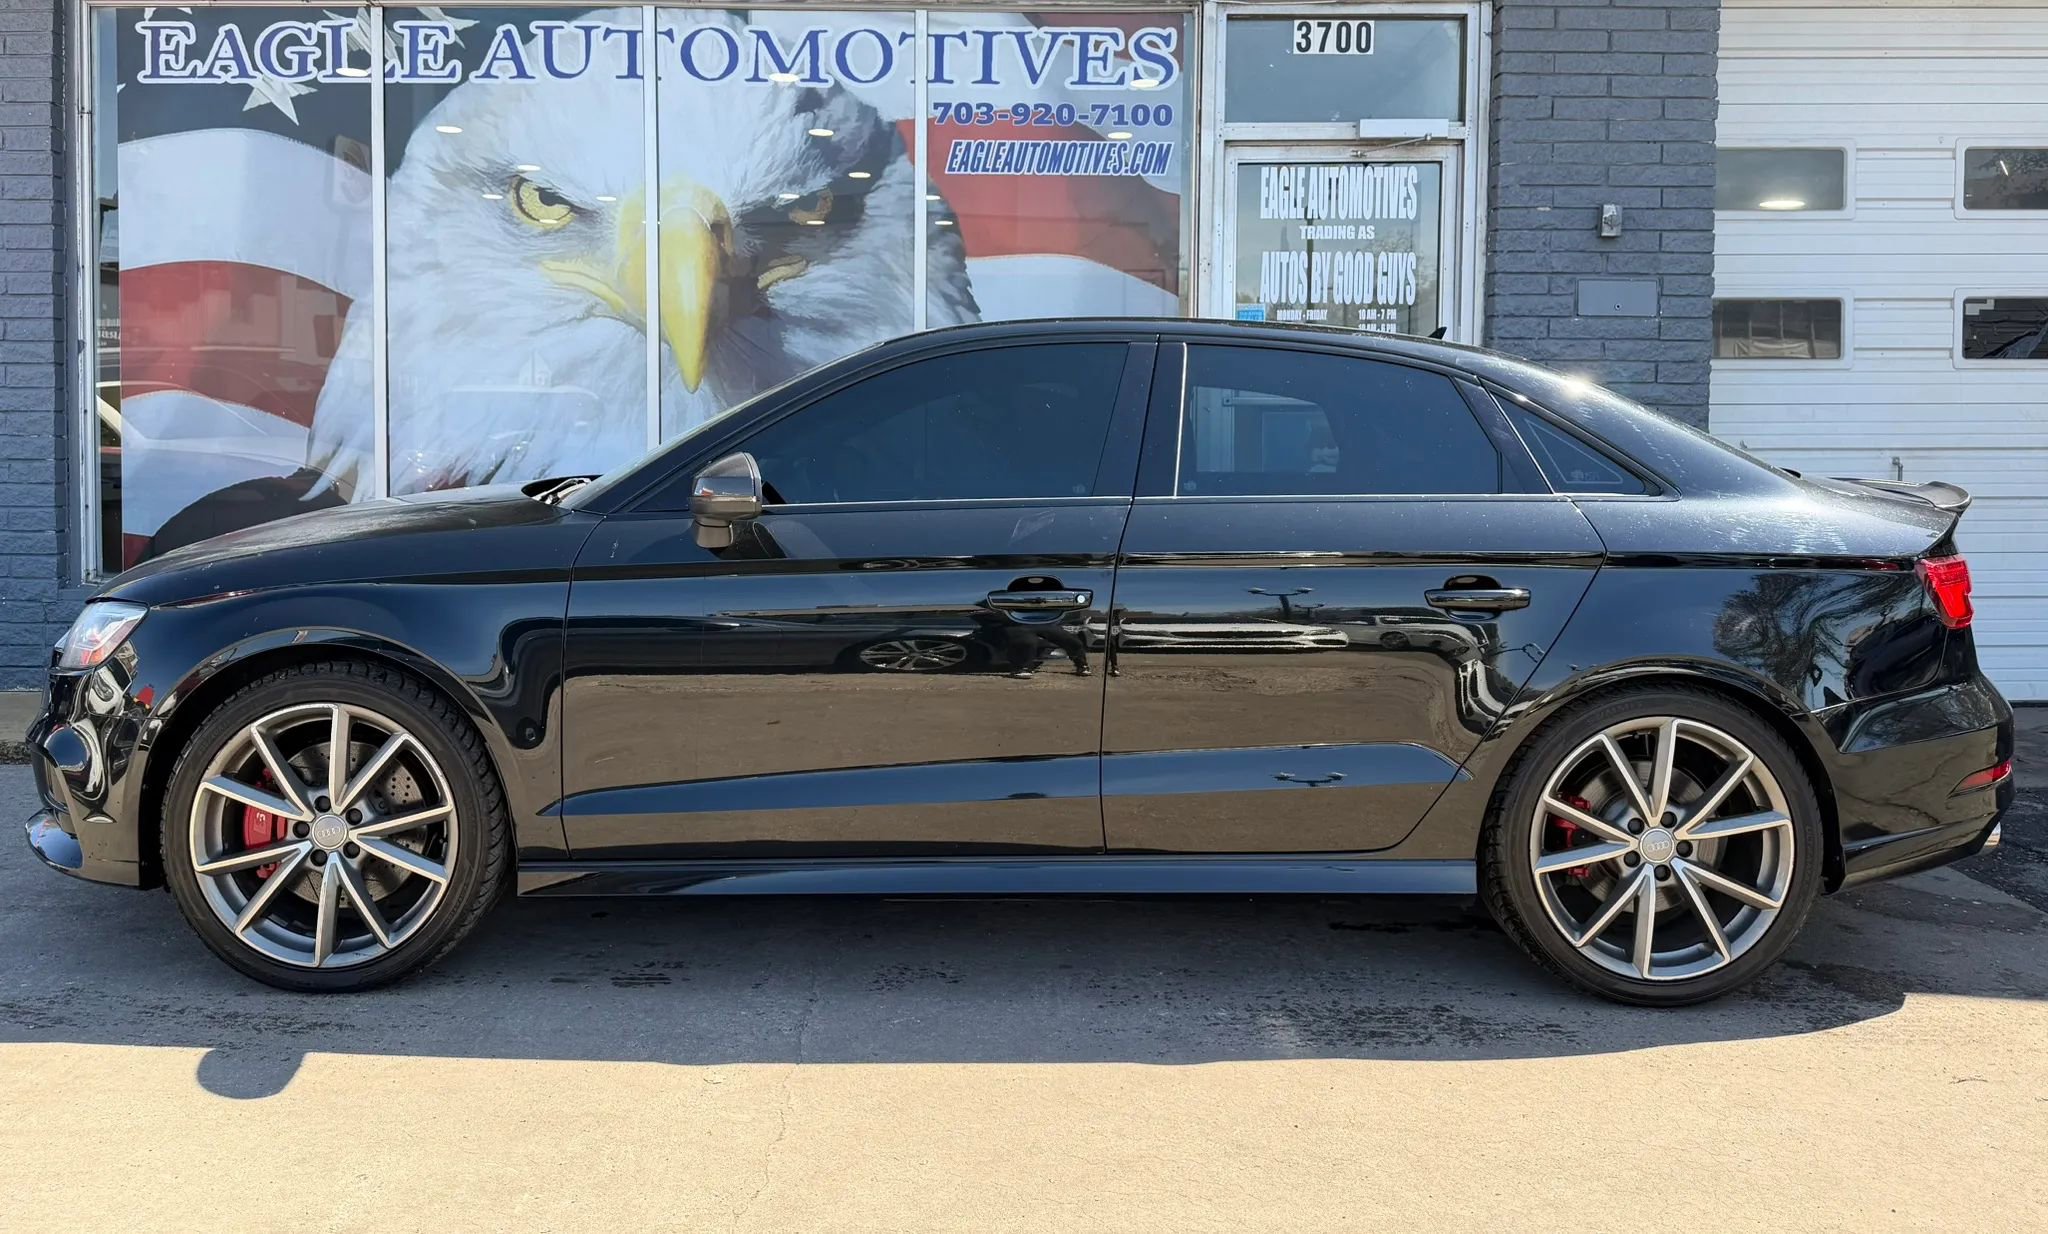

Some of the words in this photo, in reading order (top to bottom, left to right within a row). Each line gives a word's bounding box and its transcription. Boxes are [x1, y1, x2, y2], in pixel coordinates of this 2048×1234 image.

[1296, 21, 1371, 53] 3700
[136, 21, 461, 83] EAGLE
[469, 20, 1178, 90] AUTOMOTIVES
[933, 102, 1173, 126] 703-920-7100
[945, 138, 1175, 176] EAGLEAUTOMOTIVES.COM
[1260, 166, 1305, 220] EAGLE
[1306, 166, 1418, 220] AUTOMOTIVES
[1300, 225, 1355, 240] TRADING
[1357, 225, 1375, 240] AS
[1259, 250, 1308, 304] AUTOS
[1310, 251, 1331, 304] BY
[1333, 251, 1374, 305] GOOD
[1377, 251, 1416, 306] GUYS
[1276, 309, 1302, 321] MONDAY
[1306, 309, 1328, 321] FRIDAY
[1380, 308, 1385, 320] 7
[1386, 308, 1397, 320] PM
